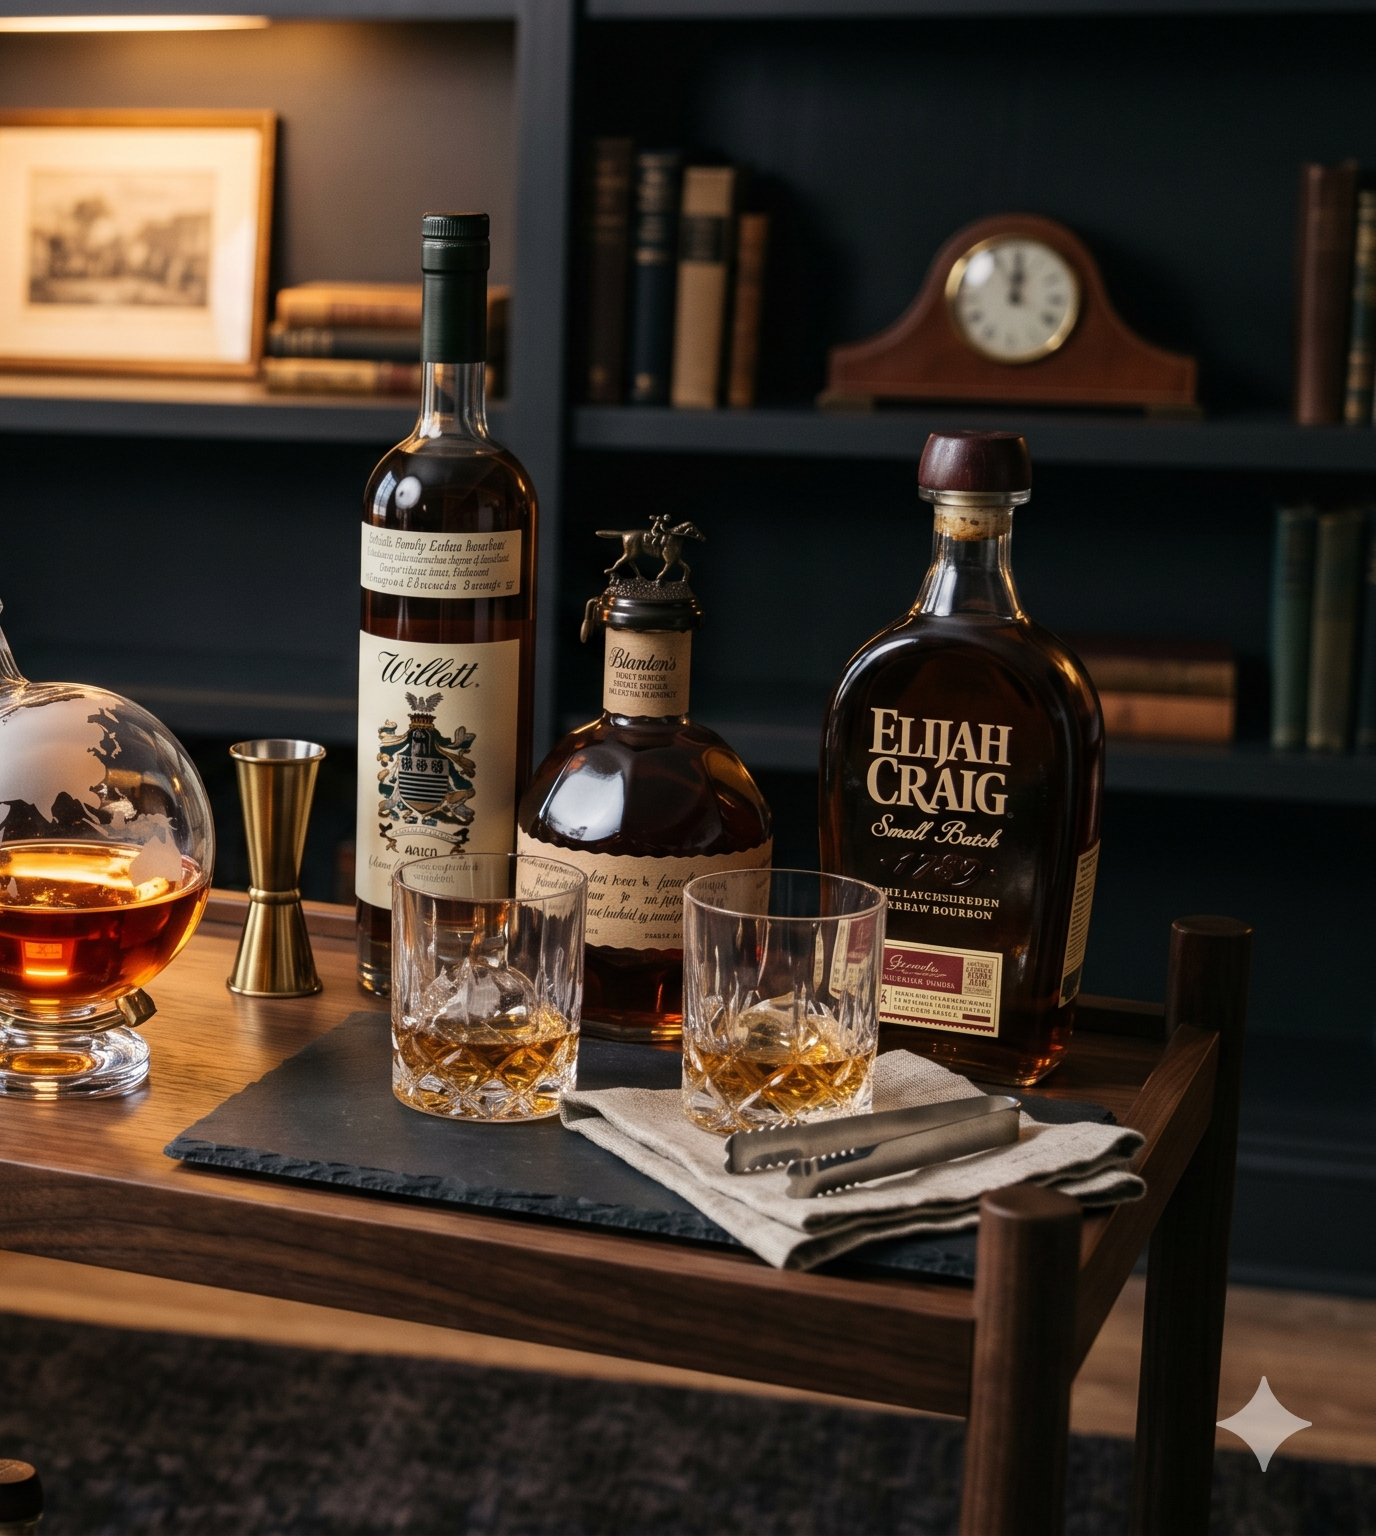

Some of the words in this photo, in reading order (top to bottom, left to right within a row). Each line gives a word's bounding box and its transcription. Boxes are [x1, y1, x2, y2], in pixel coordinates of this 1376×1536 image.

[608, 646, 677, 671] Blanton's
[868, 707, 1013, 769] ELIJAH
[866, 756, 1009, 815] CRAIG
[871, 813, 935, 841] Small
[934, 820, 1003, 849] Batch
[932, 905, 993, 920] BOURBON
